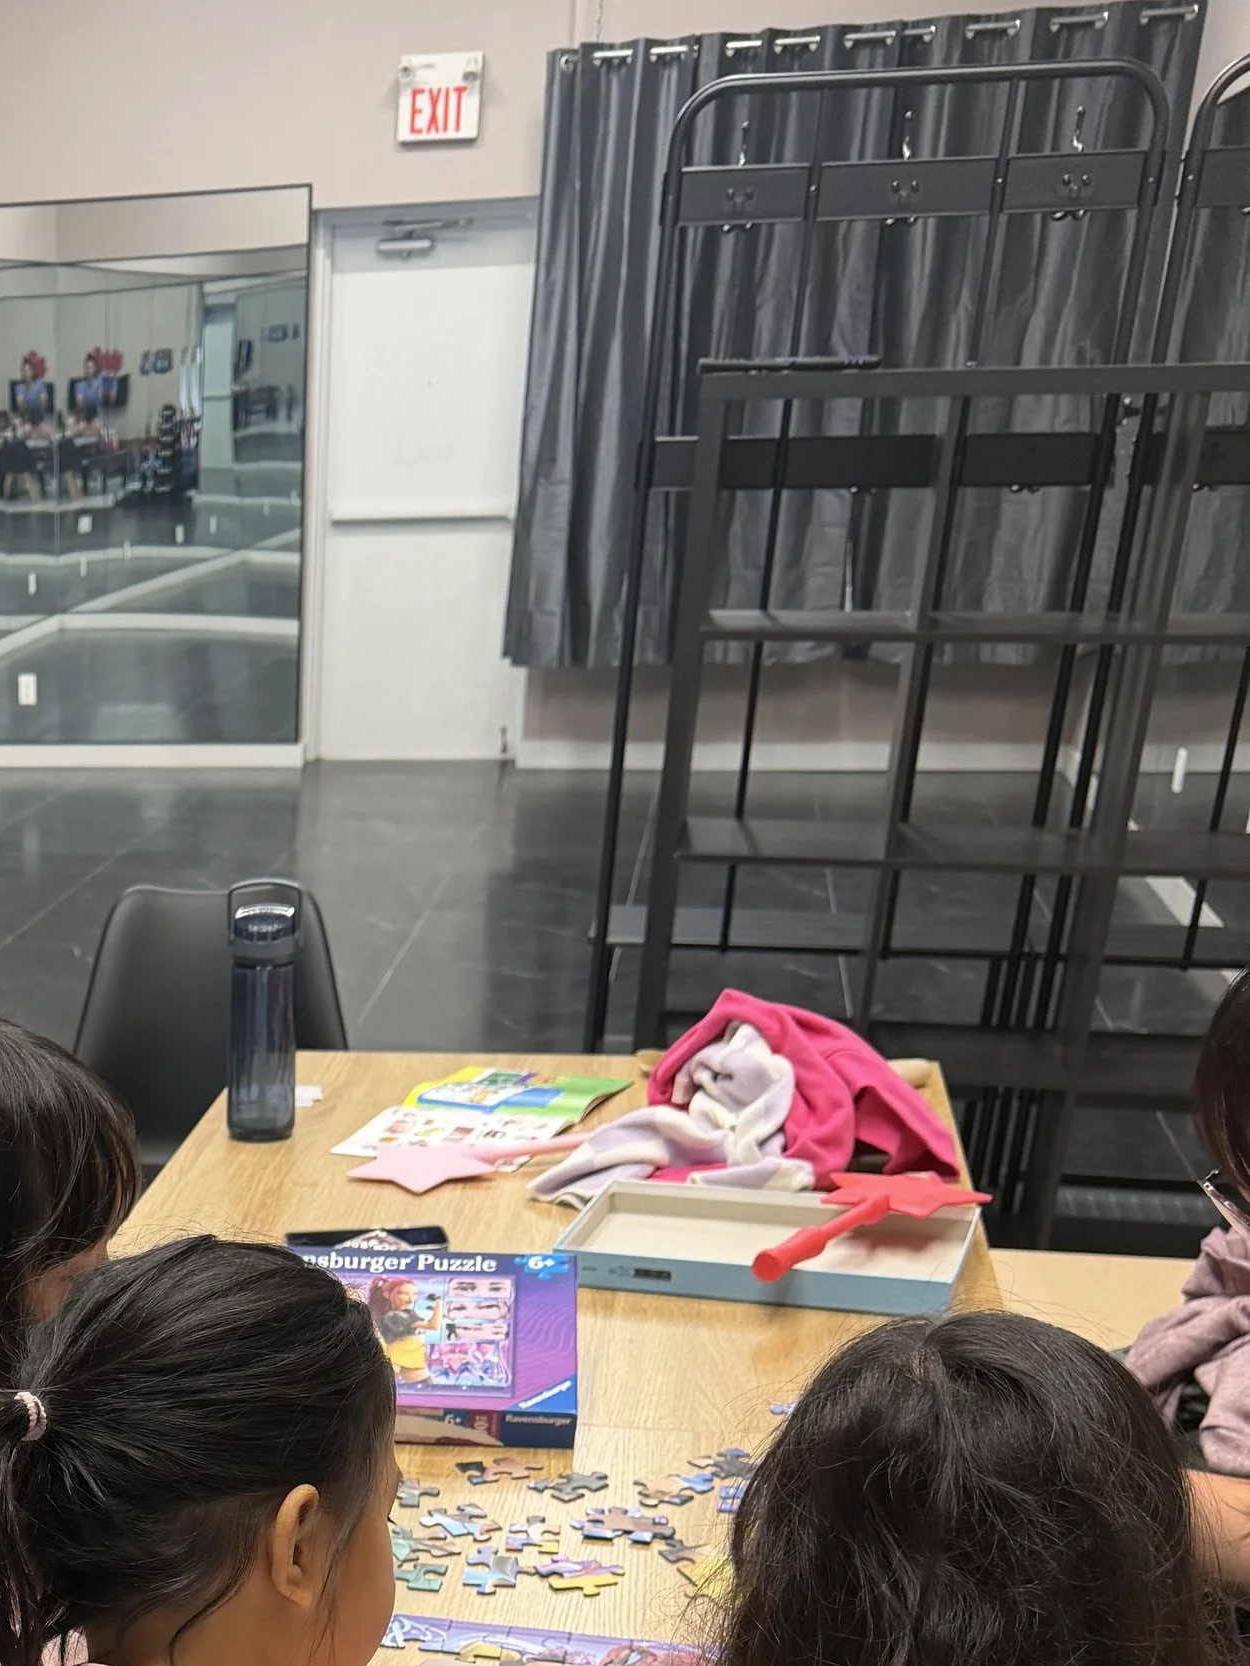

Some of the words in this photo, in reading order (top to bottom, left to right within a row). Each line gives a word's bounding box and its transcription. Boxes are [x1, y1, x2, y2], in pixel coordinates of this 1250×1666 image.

[410, 85, 467, 134] EXIT
[417, 1253, 497, 1273] Puzzle
[527, 1255, 555, 1270] 6+
[505, 1414, 571, 1427] Ravensburger
